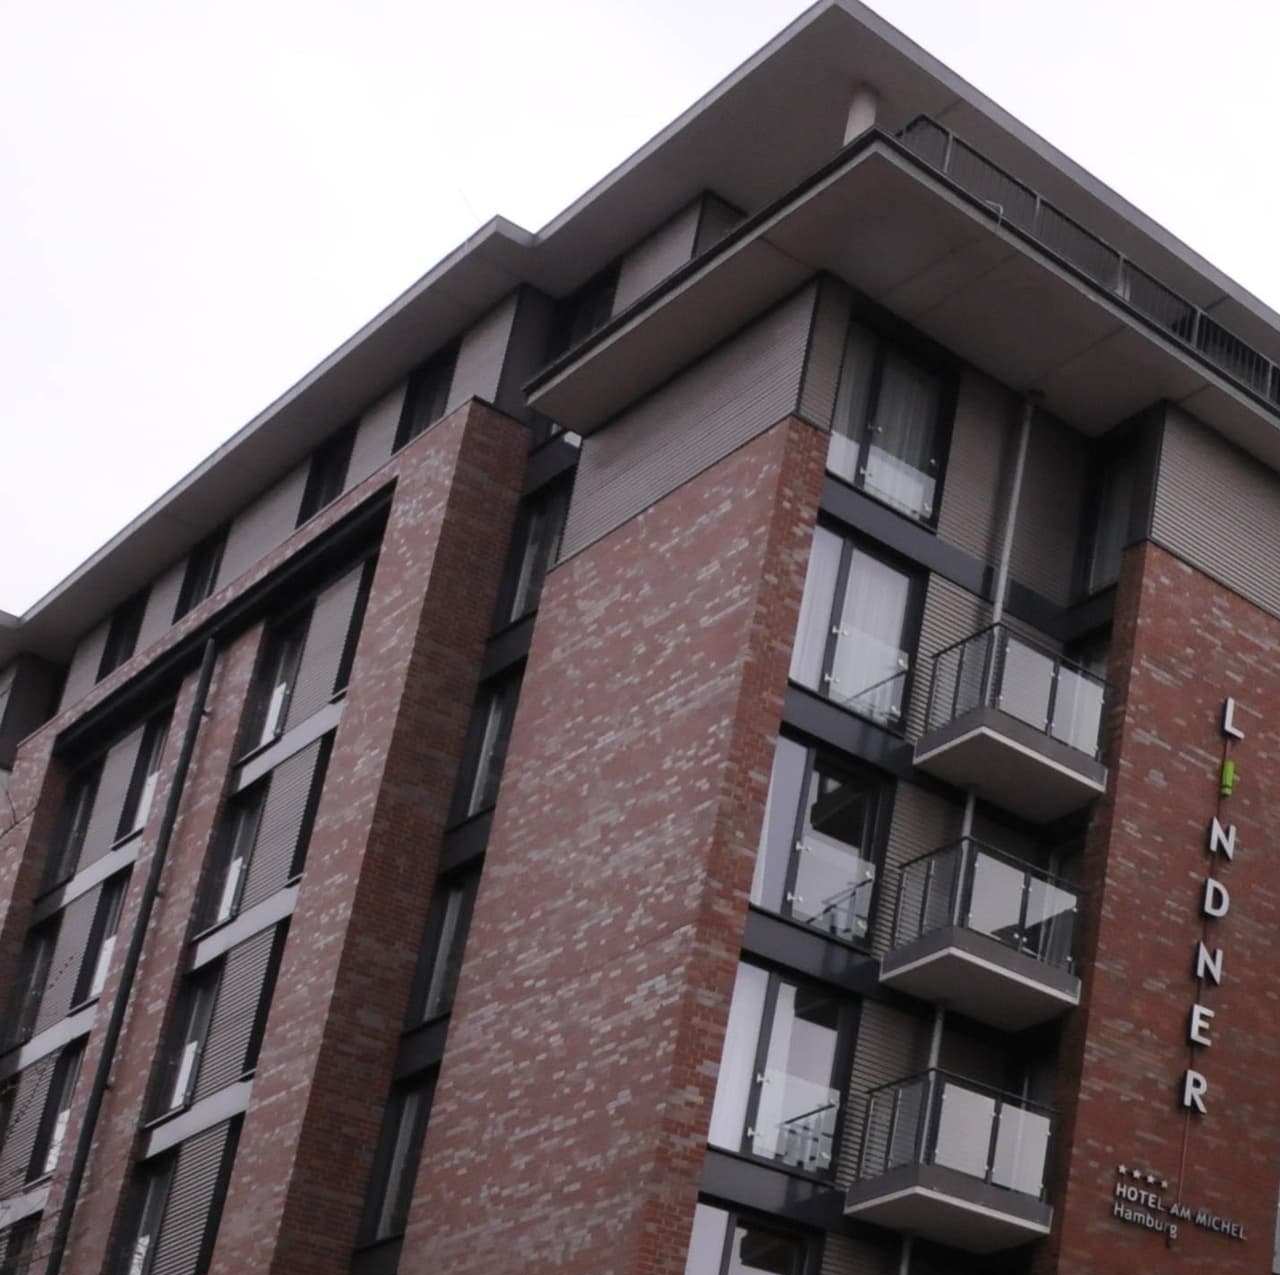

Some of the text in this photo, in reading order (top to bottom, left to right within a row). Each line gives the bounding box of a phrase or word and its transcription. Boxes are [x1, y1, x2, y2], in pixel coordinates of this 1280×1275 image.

[1113, 1202, 1178, 1239] Hamburg
[1116, 1182, 1248, 1240] HOTEL AM MICHEL
